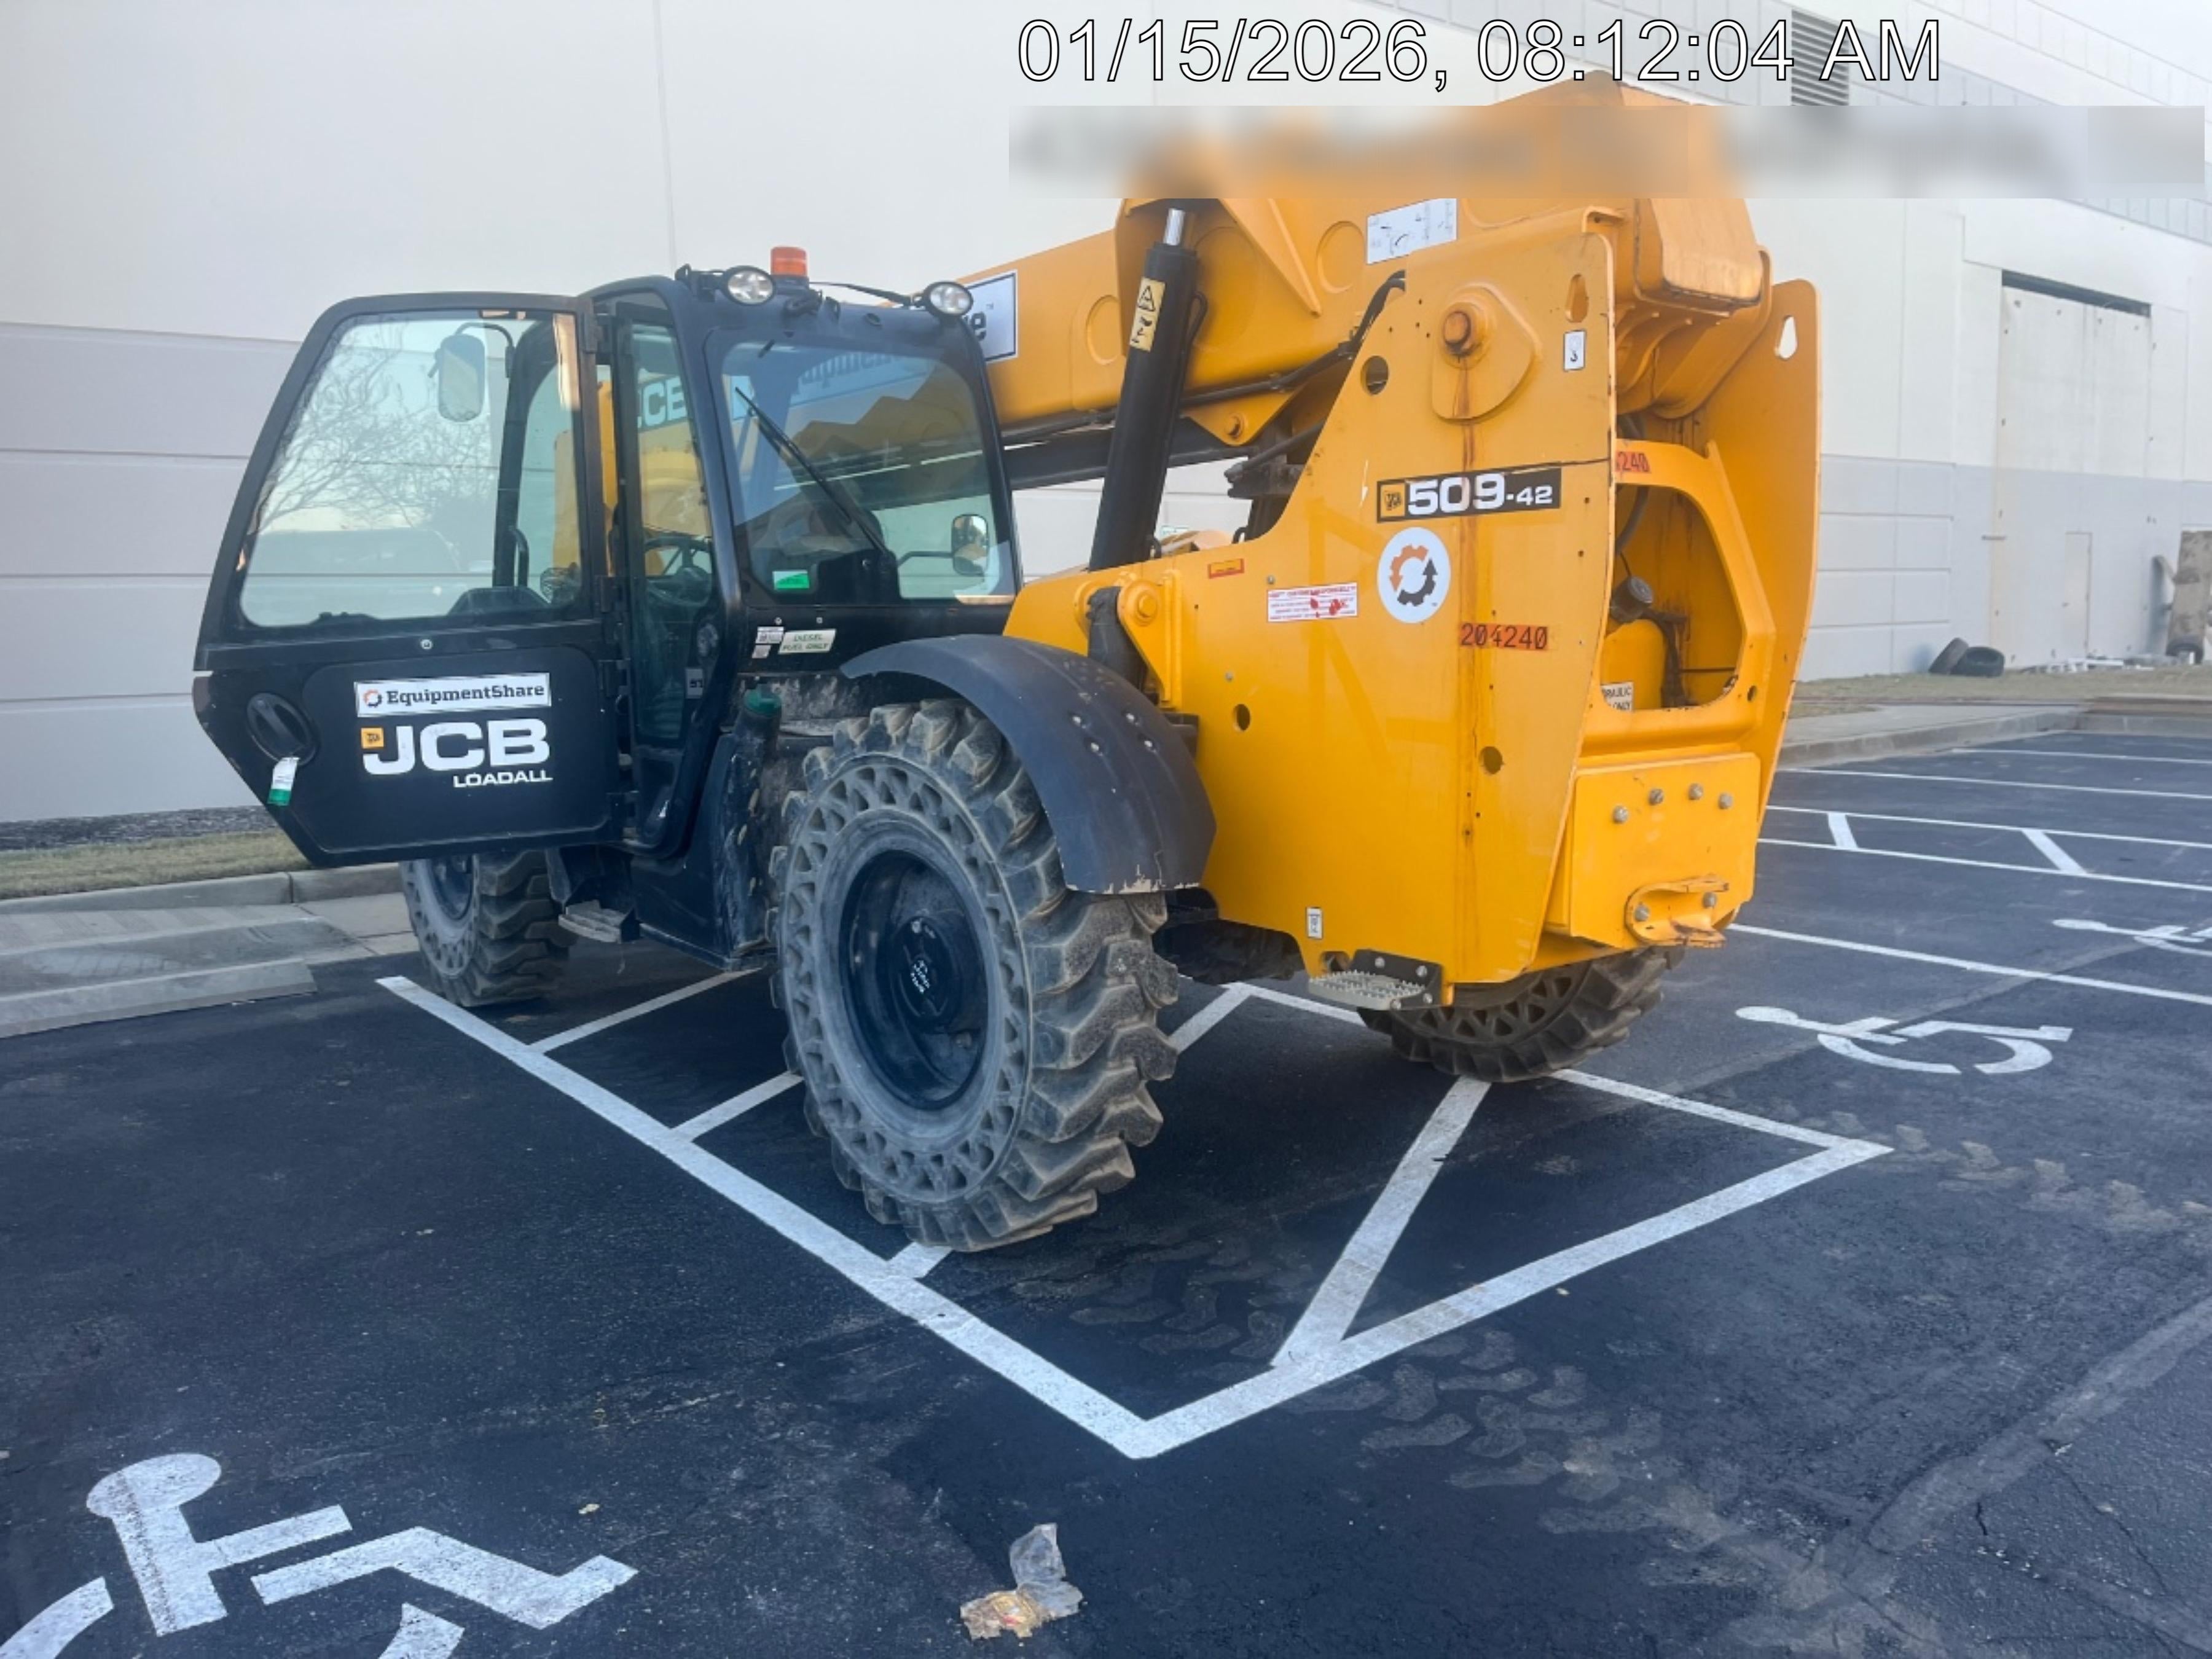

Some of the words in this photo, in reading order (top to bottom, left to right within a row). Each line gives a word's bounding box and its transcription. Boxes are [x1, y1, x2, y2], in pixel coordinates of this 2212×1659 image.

[1407, 472, 1553, 516] 509-42
[1461, 622, 1548, 649] 204240
[386, 684, 544, 706] EquipmentShare
[363, 718, 551, 775] JCB
[453, 770, 553, 788] LOADALL
